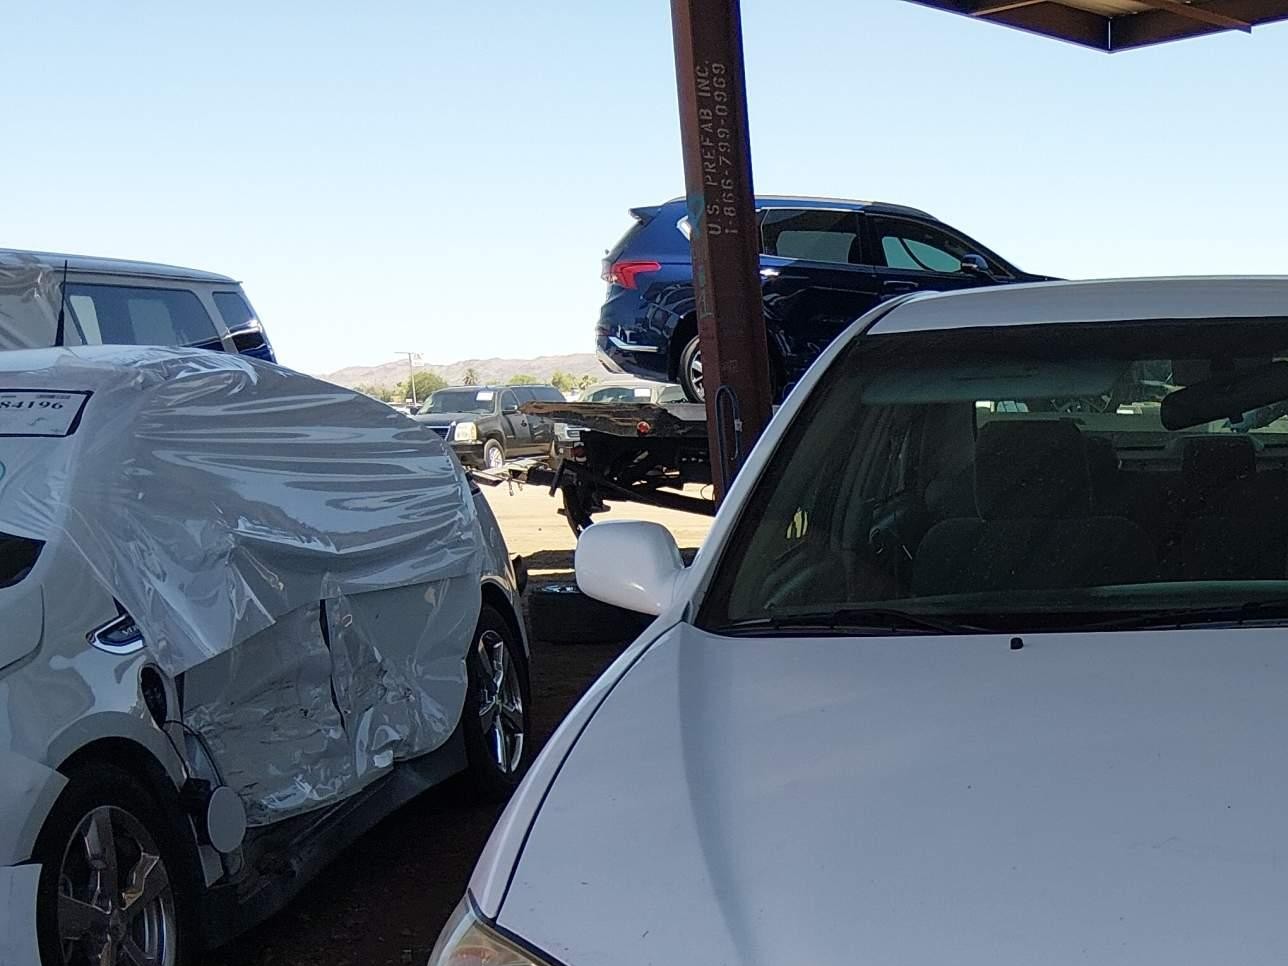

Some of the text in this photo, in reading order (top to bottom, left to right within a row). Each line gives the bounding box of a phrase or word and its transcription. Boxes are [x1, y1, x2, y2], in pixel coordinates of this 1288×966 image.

[696, 60, 722, 235] U.S. PREFAB INC.
[712, 63, 738, 234] 1-866-799-0969
